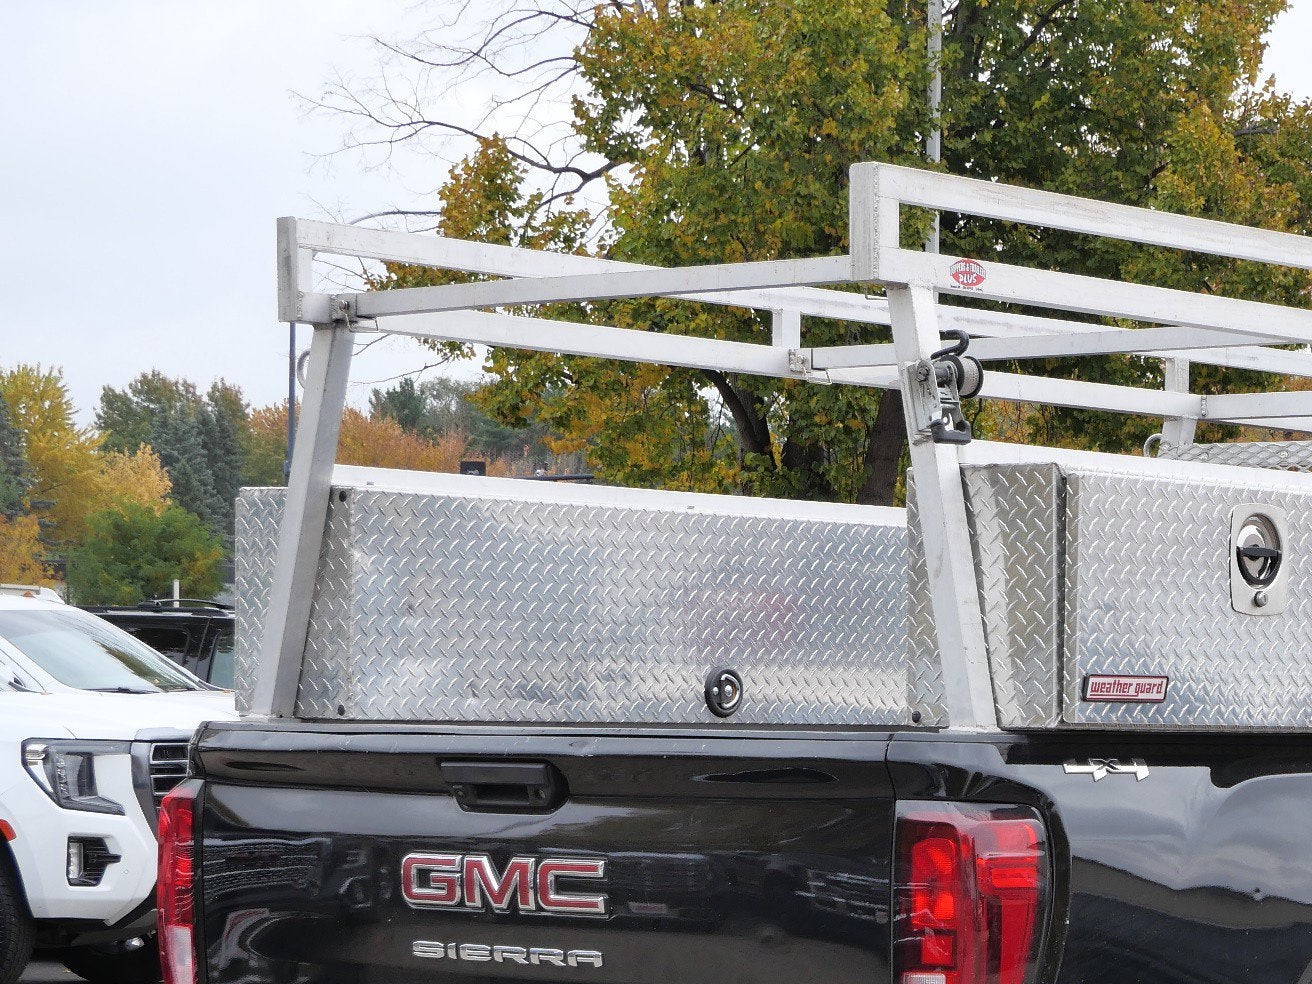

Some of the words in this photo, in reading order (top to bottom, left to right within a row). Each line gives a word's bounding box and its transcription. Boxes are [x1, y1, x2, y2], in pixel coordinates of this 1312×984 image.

[1090, 680, 1134, 694] weather
[1134, 681, 1164, 696] guard
[401, 852, 606, 914] GMC
[412, 940, 604, 968] SIERRA
